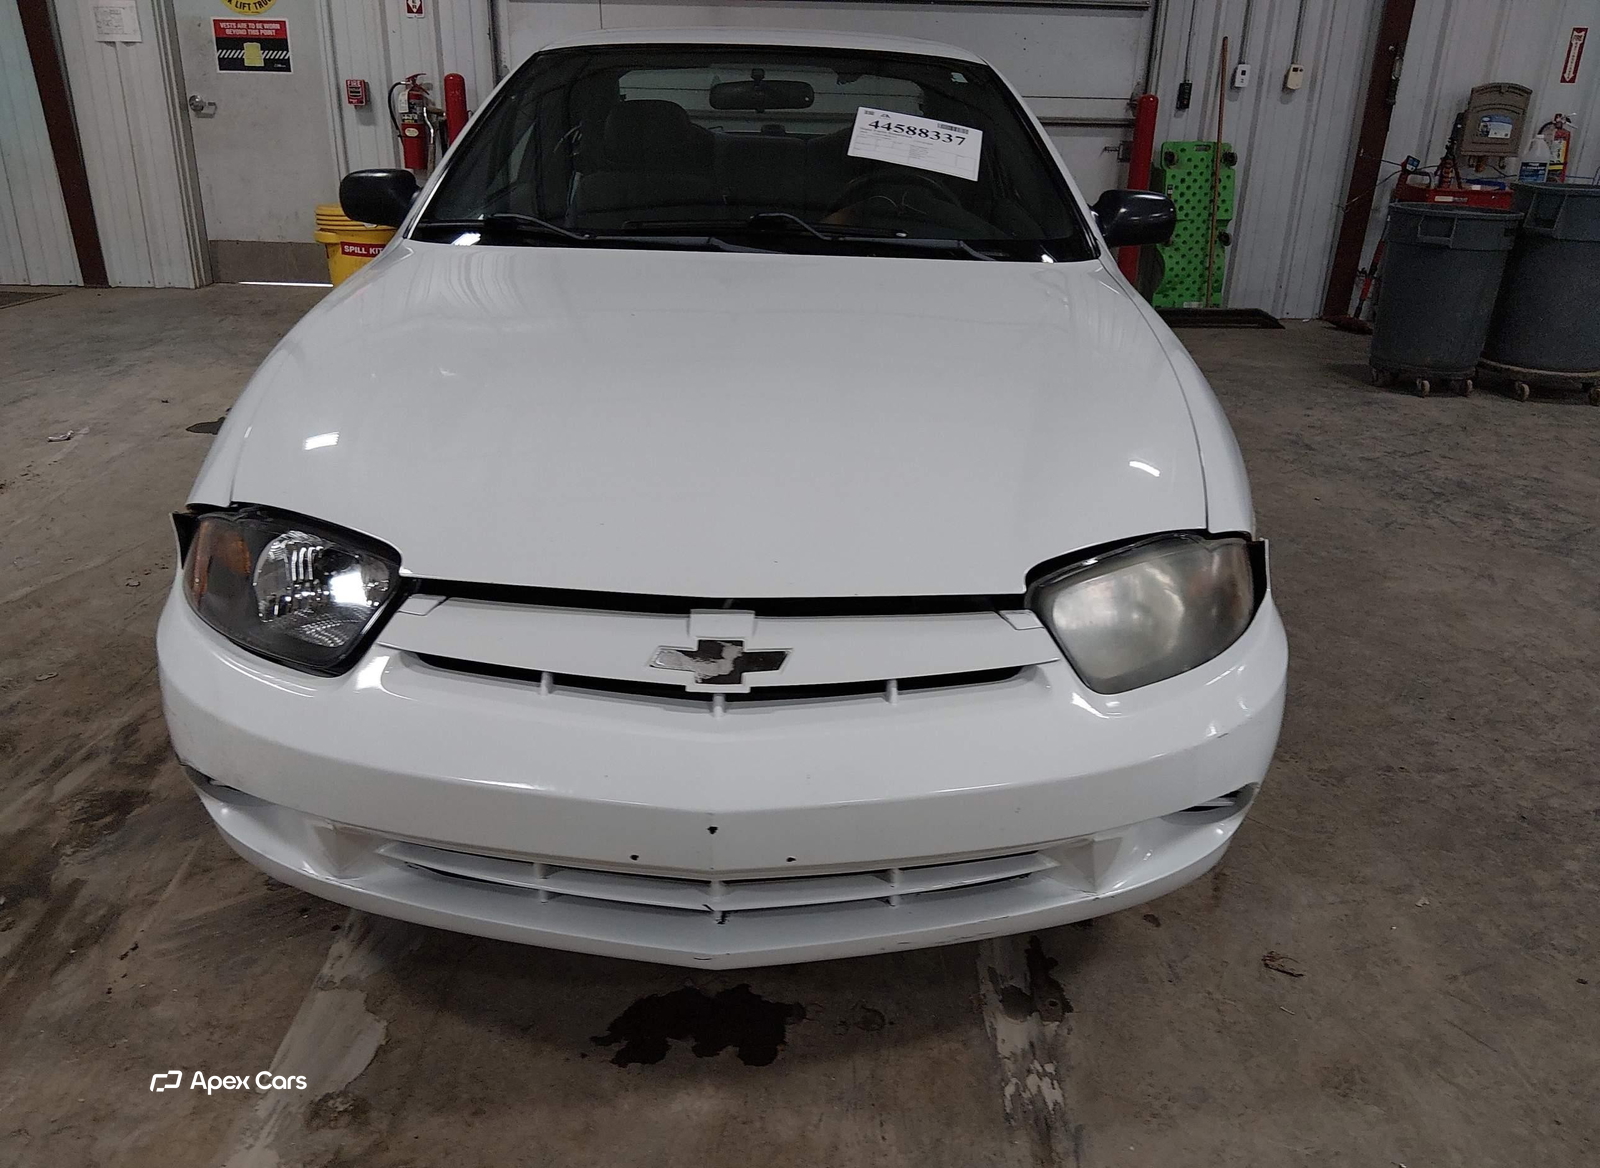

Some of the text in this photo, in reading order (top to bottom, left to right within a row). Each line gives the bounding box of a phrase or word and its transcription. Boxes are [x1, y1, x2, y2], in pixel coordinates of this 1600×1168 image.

[234, 0, 272, 11] LIFT TRU
[868, 119, 966, 146] 44588337
[344, 245, 367, 254] SPILL
